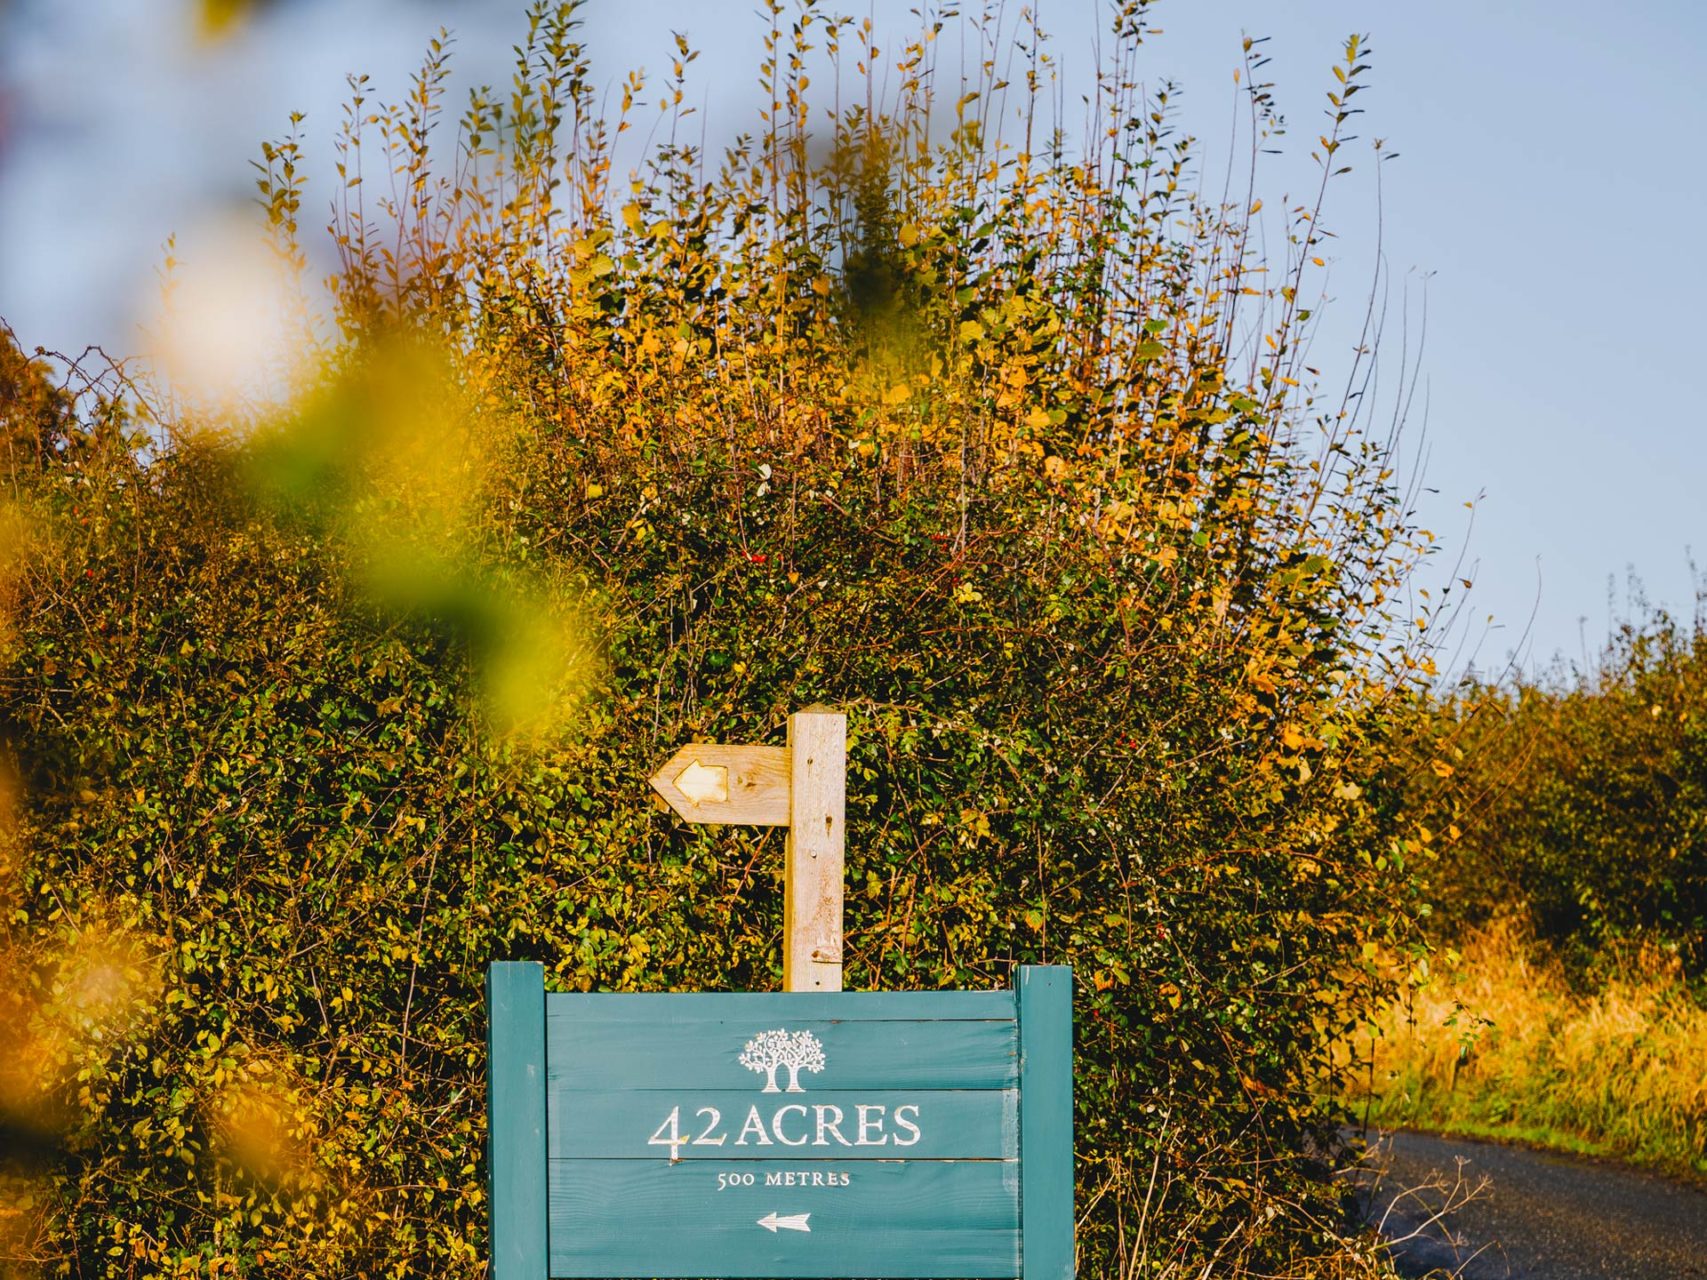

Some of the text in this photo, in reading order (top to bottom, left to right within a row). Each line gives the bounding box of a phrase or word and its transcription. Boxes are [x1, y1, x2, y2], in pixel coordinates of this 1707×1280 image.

[647, 1104, 922, 1166] 42 ACRES
[717, 1171, 851, 1192] 500 METRES
